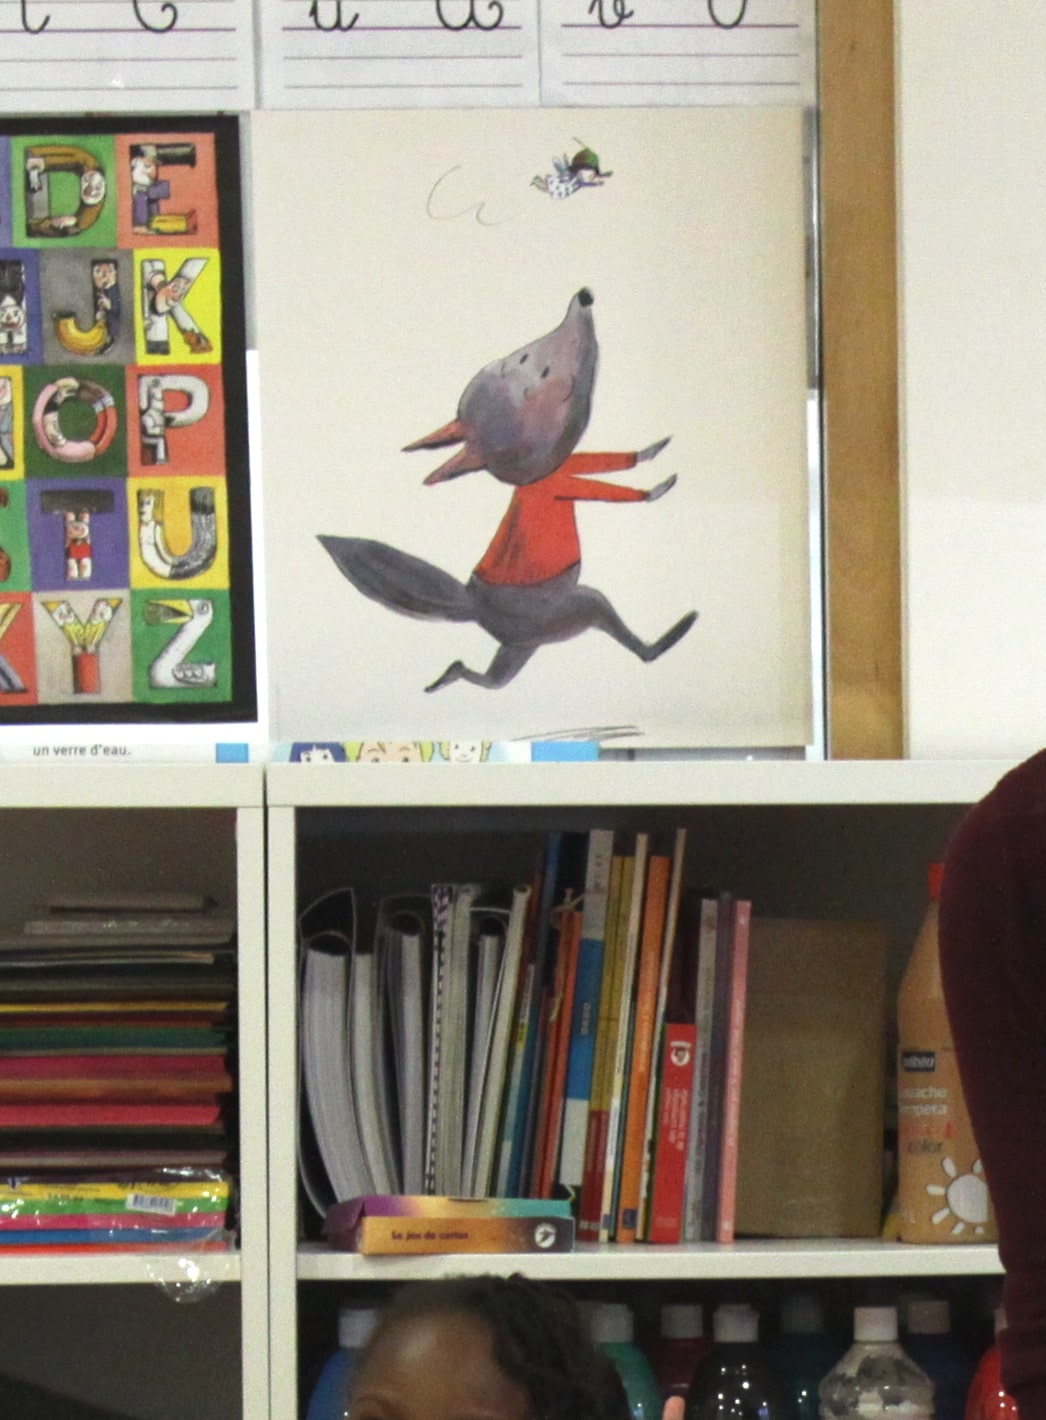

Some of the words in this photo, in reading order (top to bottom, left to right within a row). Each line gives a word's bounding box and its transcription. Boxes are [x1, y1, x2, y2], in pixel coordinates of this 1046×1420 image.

[24, 144, 106, 237] D
[129, 143, 197, 235] E
[53, 258, 121, 355] J
[141, 257, 213, 355] K
[32, 376, 118, 463] O
[138, 374, 210, 466] P
[40, 489, 115, 581] T
[137, 486, 218, 580] U
[41, 598, 123, 694] Y
[143, 598, 218, 688] Z
[33, 746, 49, 756] un
[53, 746, 86, 756] verre
